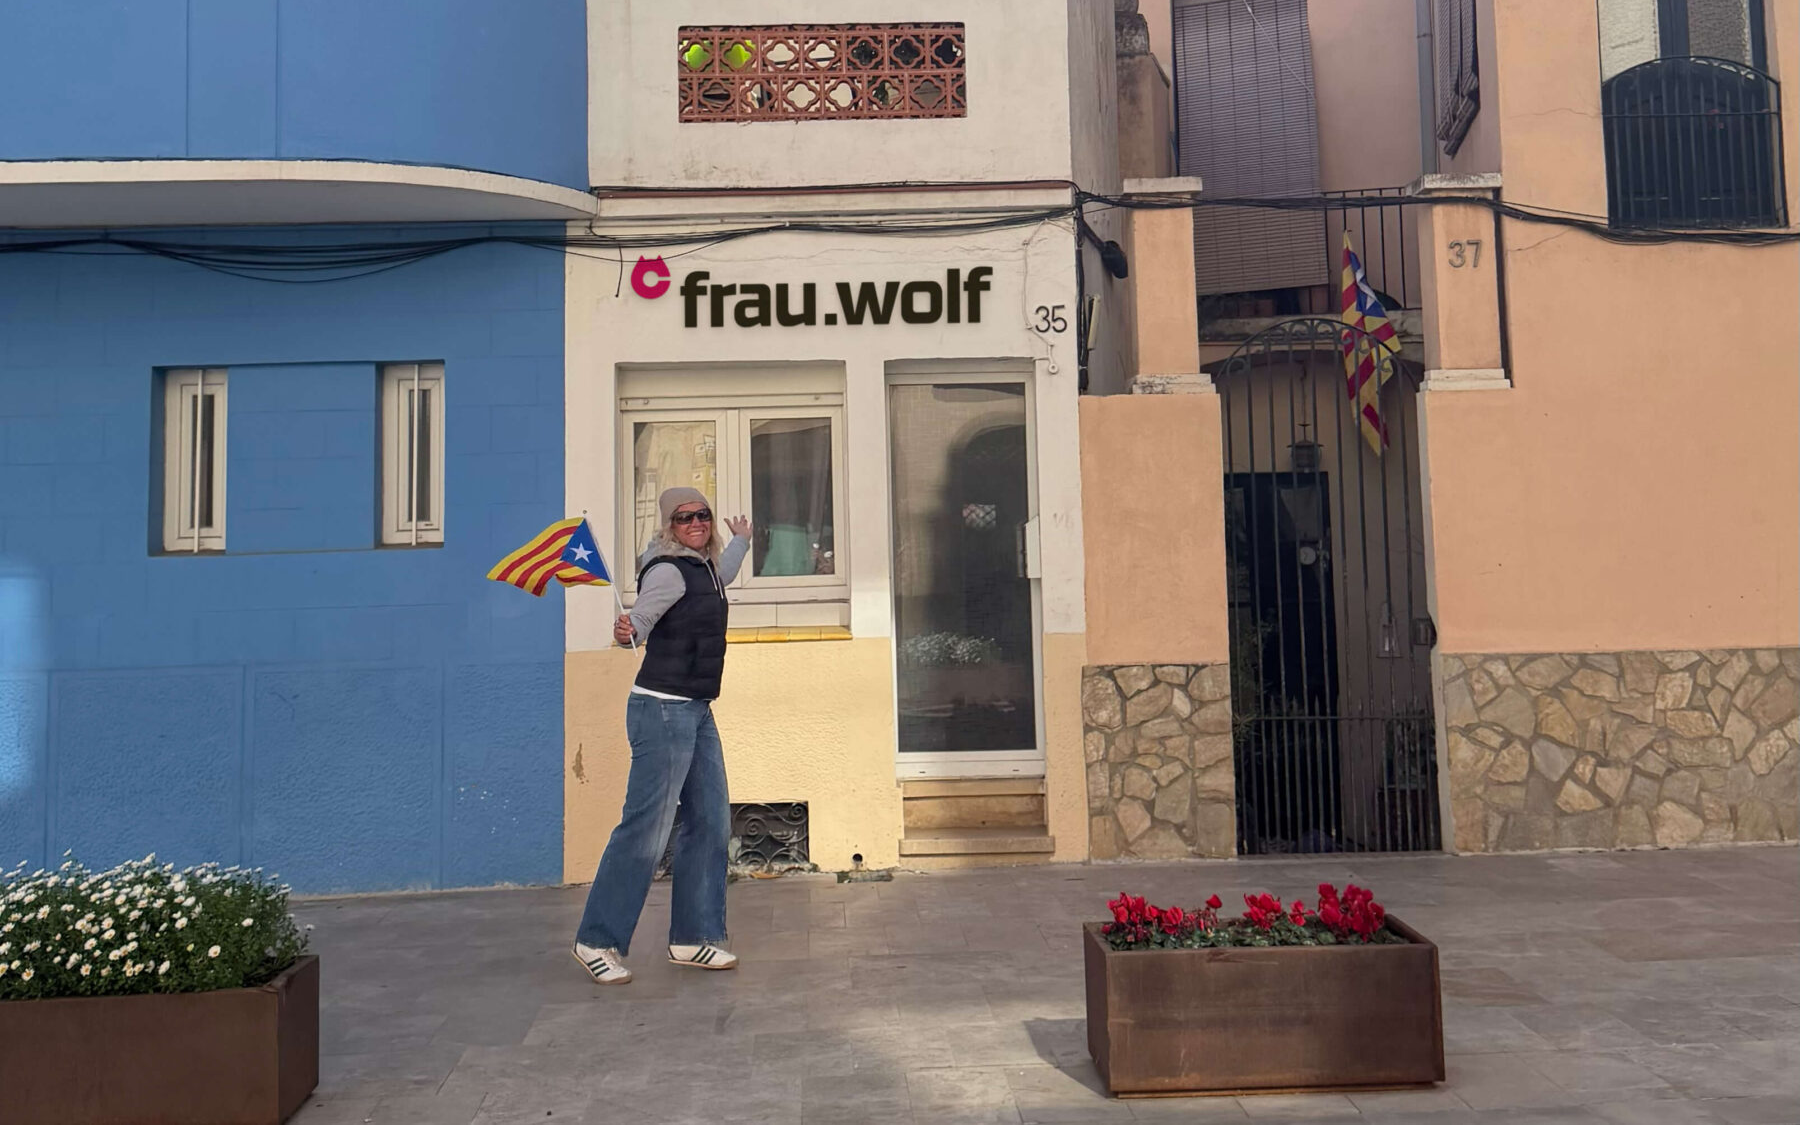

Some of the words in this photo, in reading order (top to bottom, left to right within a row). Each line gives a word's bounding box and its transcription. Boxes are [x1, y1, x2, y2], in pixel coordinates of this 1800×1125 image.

[1448, 240, 1482, 268] 37
[680, 266, 993, 328] frau.wolf
[1034, 305, 1068, 333] 35
